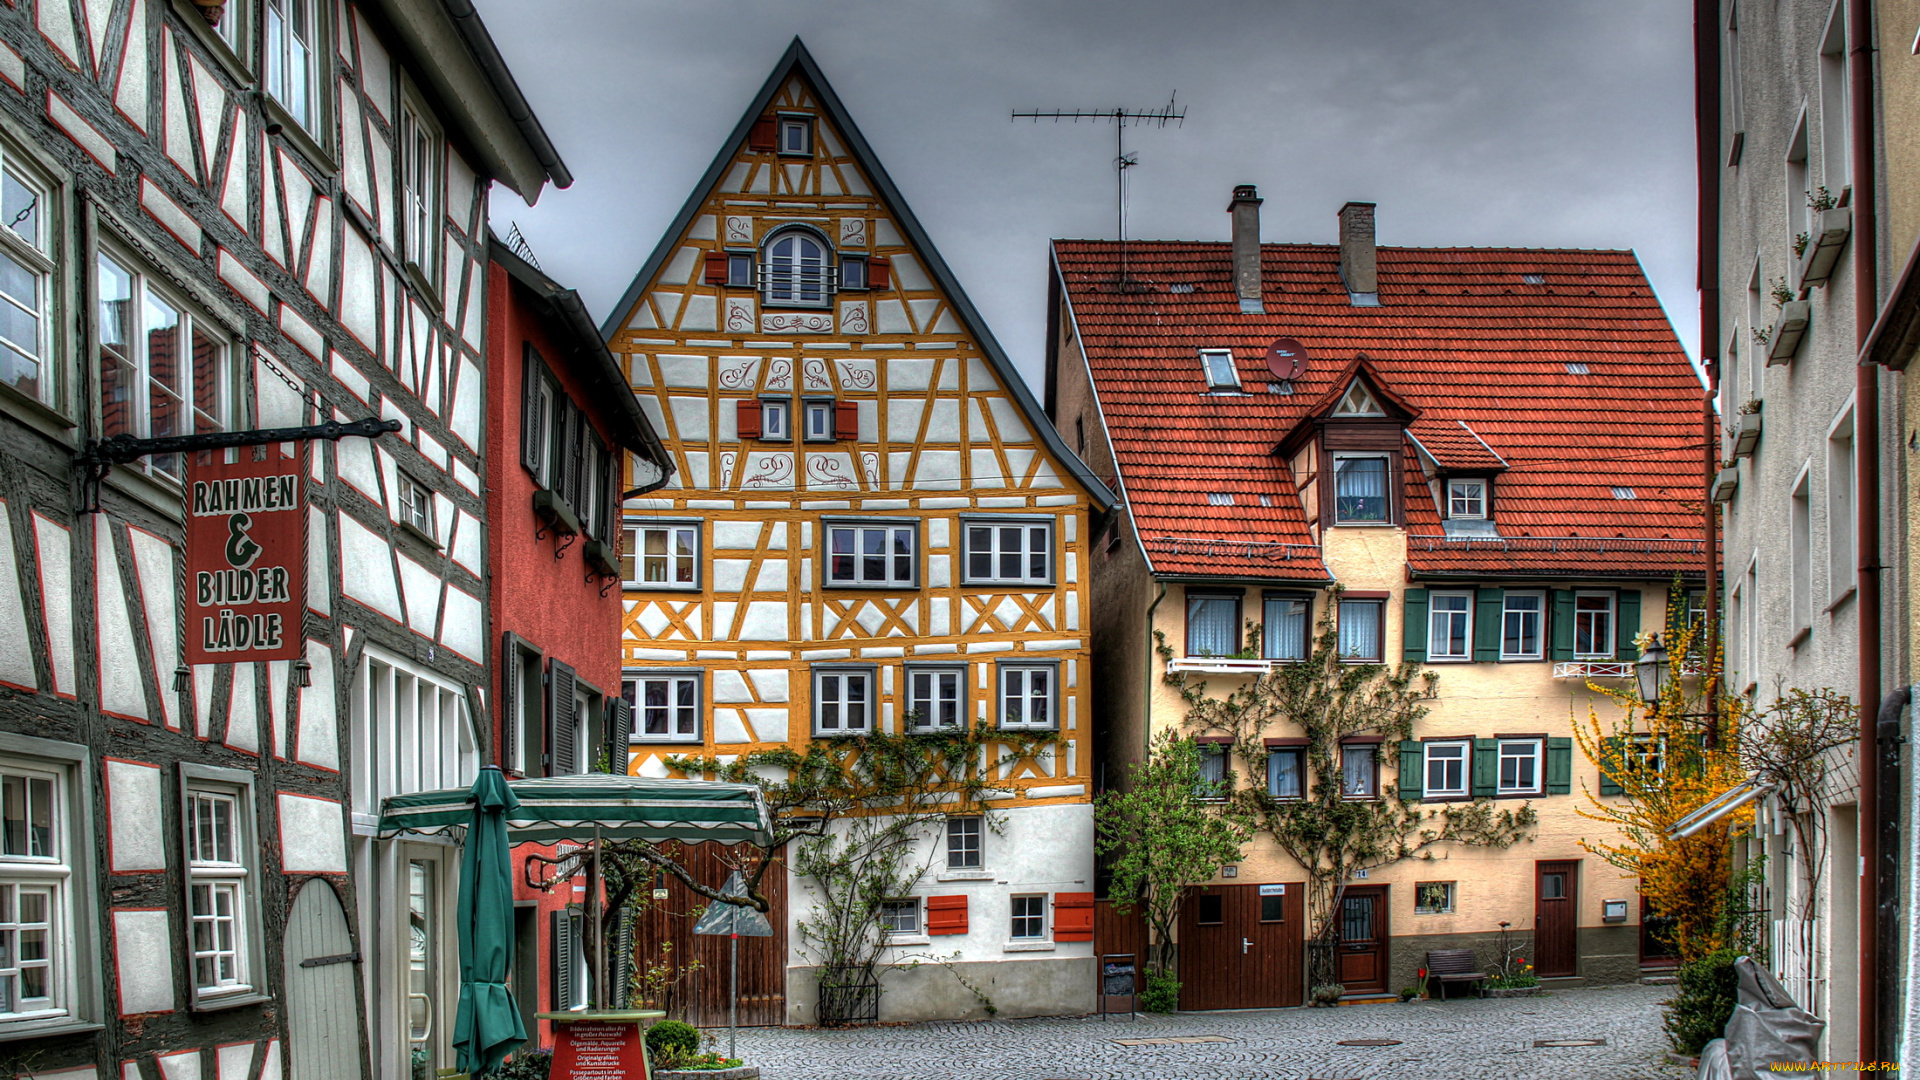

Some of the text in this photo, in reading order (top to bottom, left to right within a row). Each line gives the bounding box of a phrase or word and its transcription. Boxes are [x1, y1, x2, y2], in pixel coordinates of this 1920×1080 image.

[192, 474, 298, 517] RAHMEN
[225, 512, 263, 570] &
[197, 566, 290, 607] BILDER
[203, 609, 283, 652] LÄDLE
